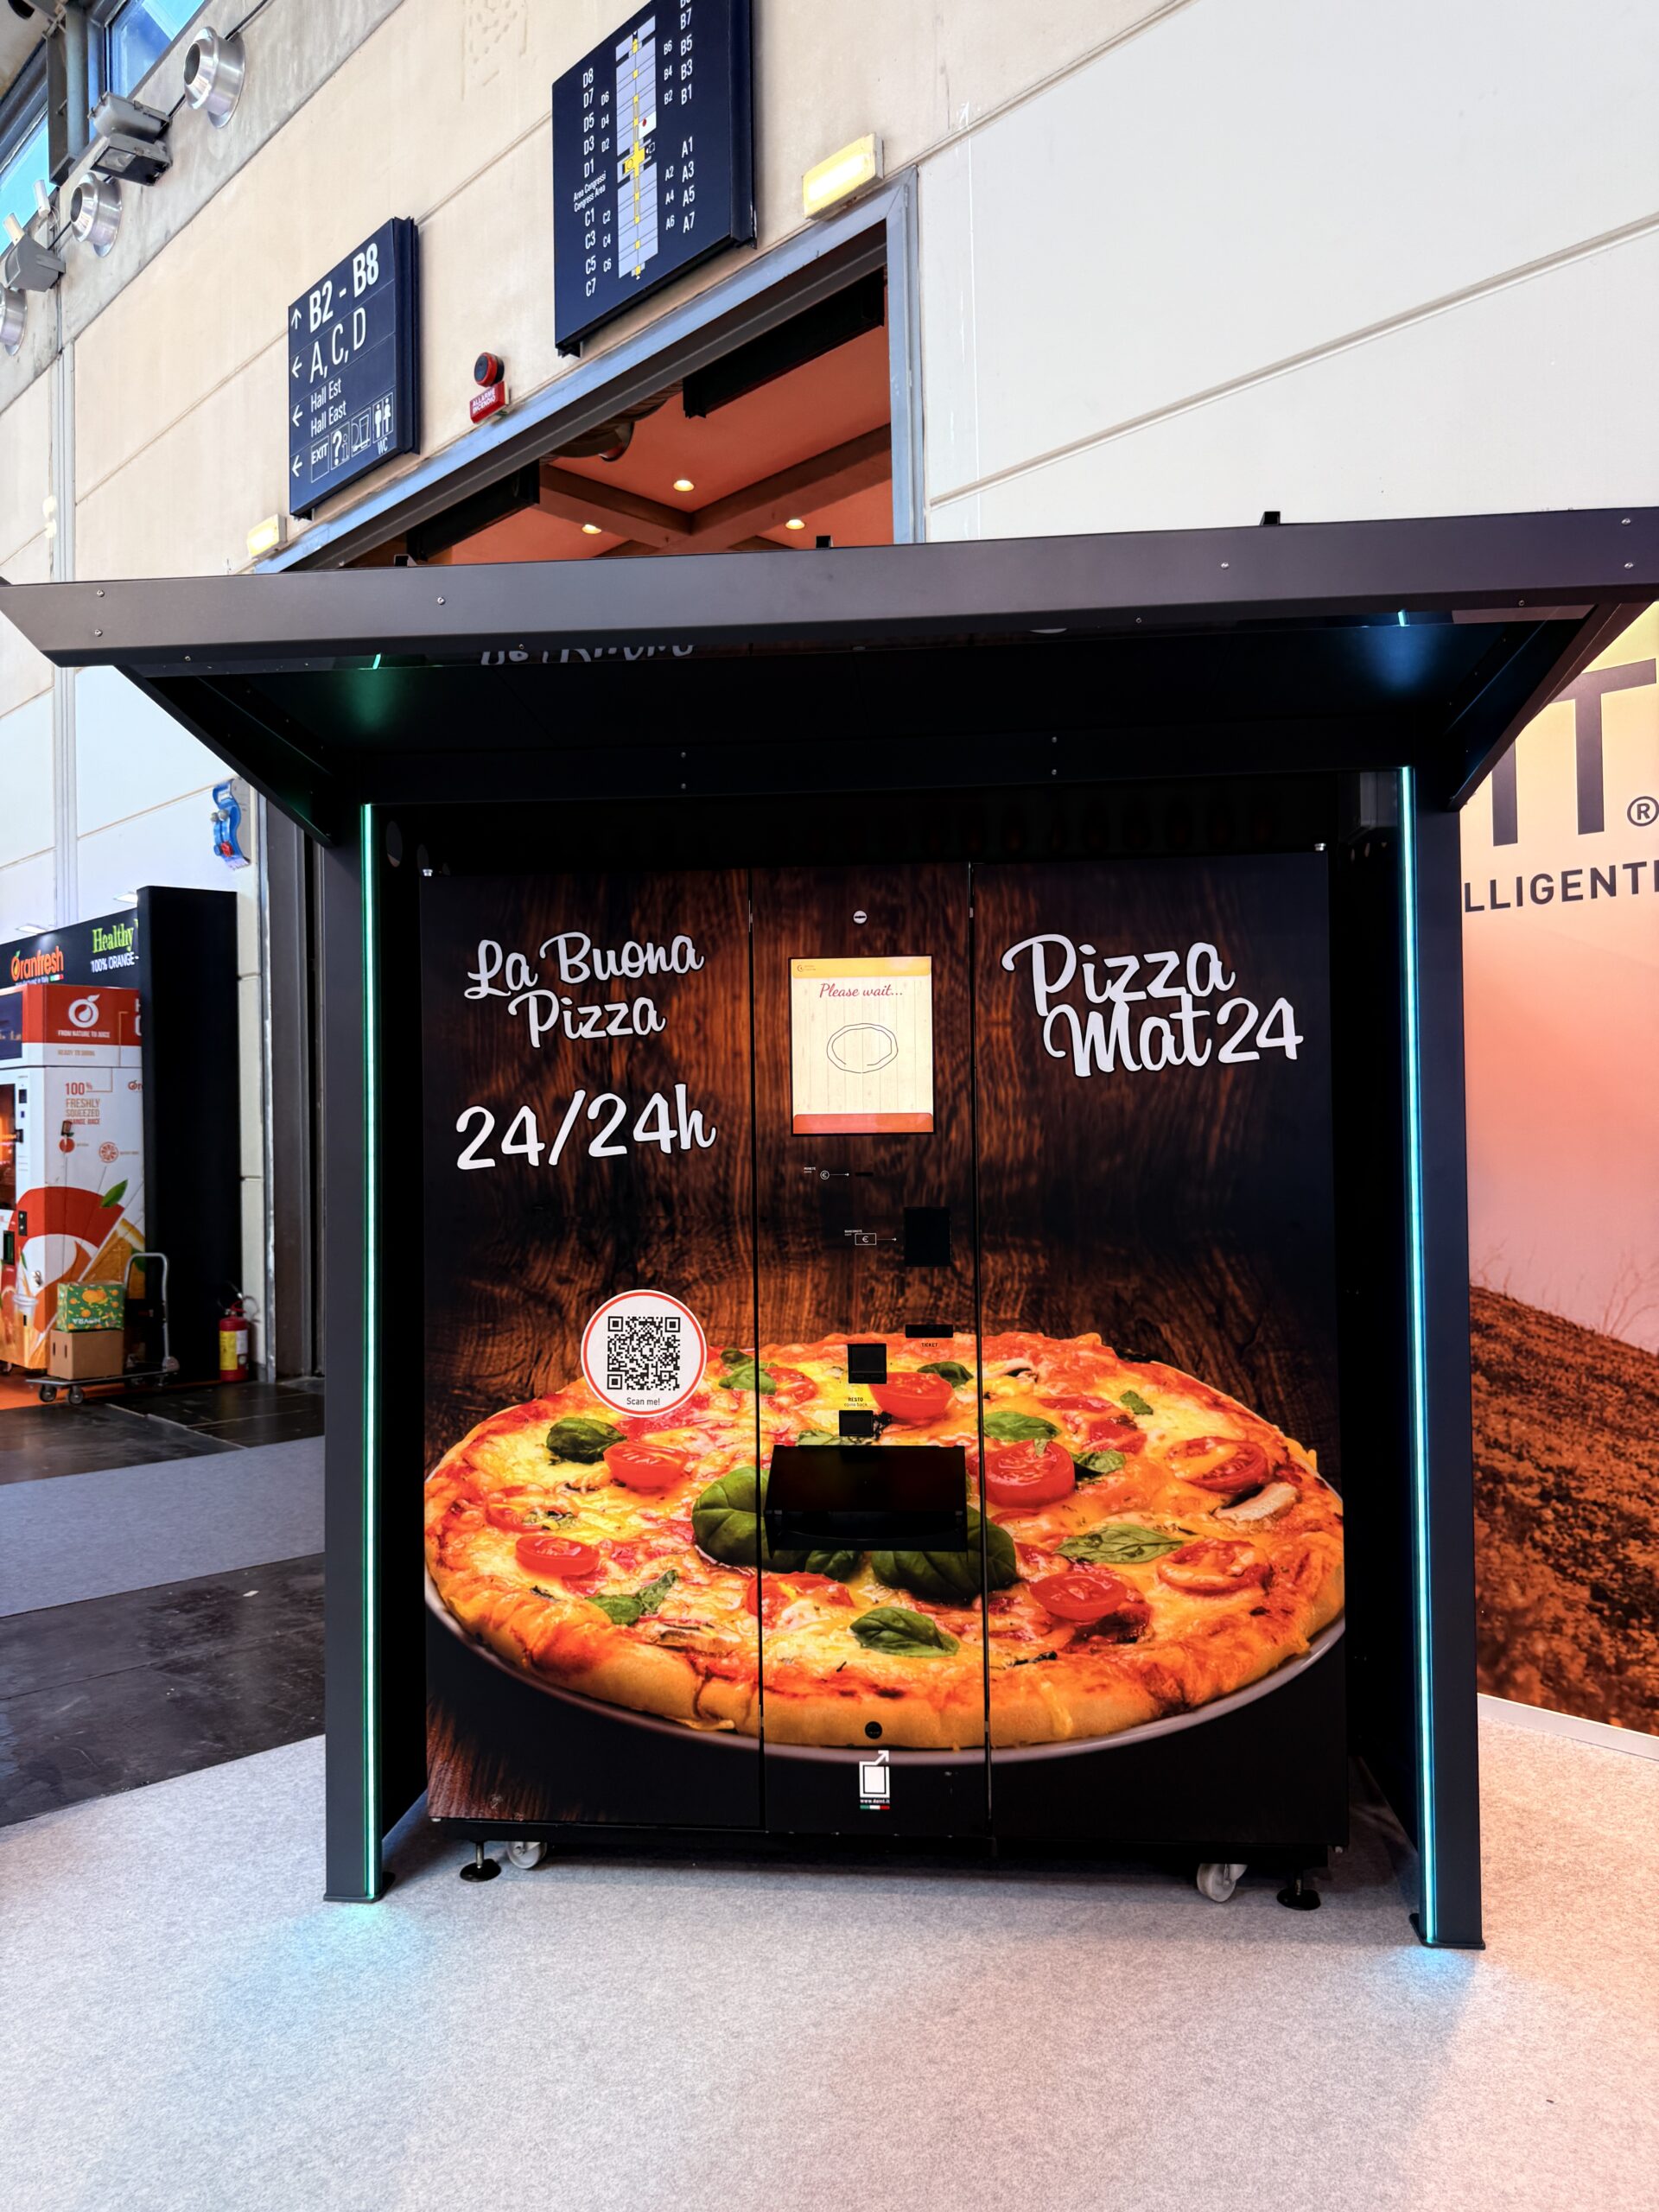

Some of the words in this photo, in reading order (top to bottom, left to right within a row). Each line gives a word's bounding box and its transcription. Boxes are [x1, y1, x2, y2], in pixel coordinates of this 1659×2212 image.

[681, 8, 692, 30] B7
[664, 40, 672, 55] B6
[681, 35, 692, 56] B5
[583, 68, 594, 88] D8
[664, 65, 672, 80] B4
[681, 59, 692, 80] B3
[583, 88, 594, 108] D7
[601, 92, 609, 106] D6
[664, 90, 672, 105] B2
[681, 84, 692, 105] B1
[583, 112, 594, 132] D5
[601, 114, 609, 129] D4
[584, 136, 594, 156] D3
[601, 138, 610, 153] D2
[682, 137, 693, 158] A1
[584, 158, 594, 178] D1
[664, 165, 674, 181] A2
[682, 161, 694, 182] A3
[574, 189, 584, 202] Area
[584, 170, 607, 194] Congressi
[683, 185, 695, 207] A5
[574, 193, 594, 213] Congress
[594, 184, 606, 199] Area
[665, 189, 674, 205] A4
[585, 207, 594, 226] C1
[602, 210, 611, 225] C2
[665, 215, 675, 230] A6
[683, 212, 695, 233] A7
[585, 230, 595, 250] C3
[603, 233, 611, 248] C4
[586, 255, 596, 275] C5
[603, 257, 611, 273] C6
[309, 280, 334, 334] B2
[353, 243, 379, 298] B8
[586, 277, 596, 297] C7
[353, 307, 366, 351] D
[310, 385, 327, 413] Hall
[328, 378, 341, 401] Est
[310, 410, 327, 437] Hall
[328, 401, 346, 423] East
[312, 442, 328, 465] EXIT
[378, 437, 388, 456] WC
[92, 923, 134, 953] Healthy
[11, 945, 64, 982] Oranfresh
[91, 957, 108, 973] 100%
[464, 939, 537, 1000] La
[539, 931, 704, 984] Buona
[1001, 933, 1236, 1016] Pizza
[819, 982, 860, 999] Please
[862, 984, 903, 997] wait...
[508, 989, 665, 1048] Pizza
[65, 1082, 92, 1095] 100%
[66, 1098, 100, 1108] FRESHLY
[66, 1109, 100, 1117] SQUEEZED
[455, 1084, 716, 1170] 24/24h
[626, 1397, 645, 1406] Scan
